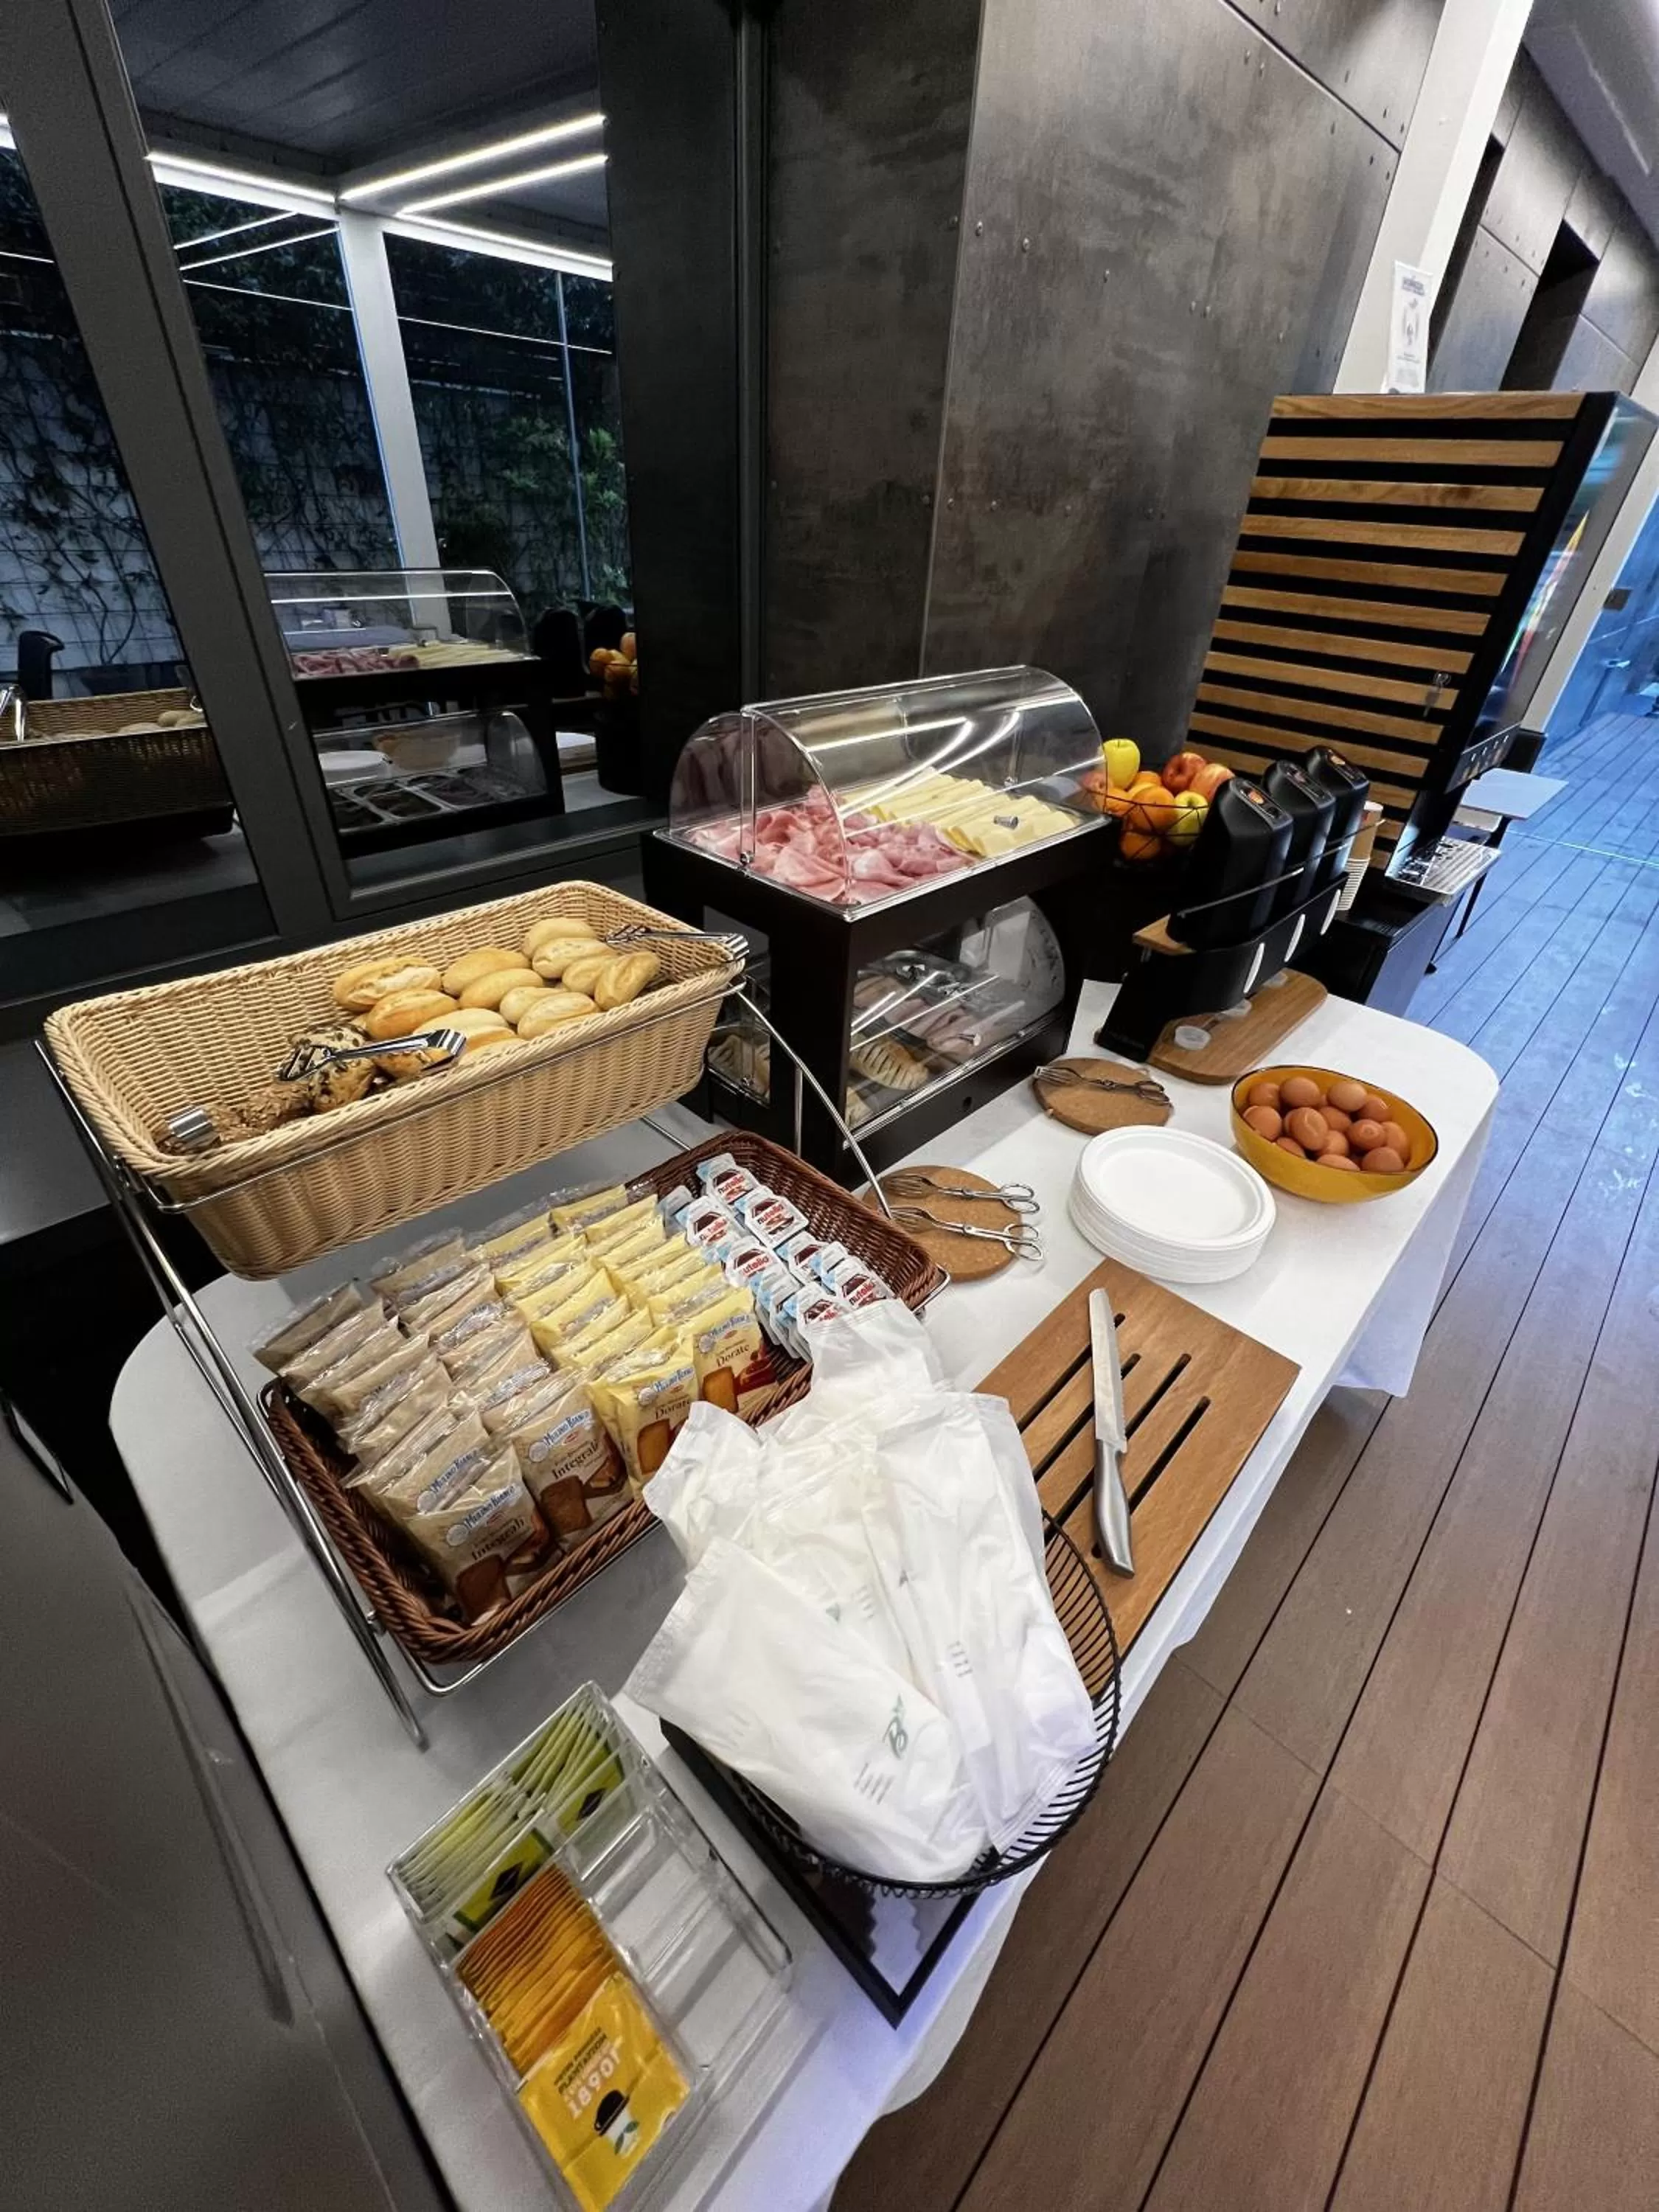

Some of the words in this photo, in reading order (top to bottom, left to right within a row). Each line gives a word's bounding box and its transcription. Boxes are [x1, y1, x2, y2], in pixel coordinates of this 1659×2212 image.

[718, 1175, 745, 1194] nutella
[757, 1203, 785, 1225] nutella
[742, 1255, 770, 1274] utella
[849, 1282, 875, 1306] nutella
[715, 1343, 751, 1367] Dorate
